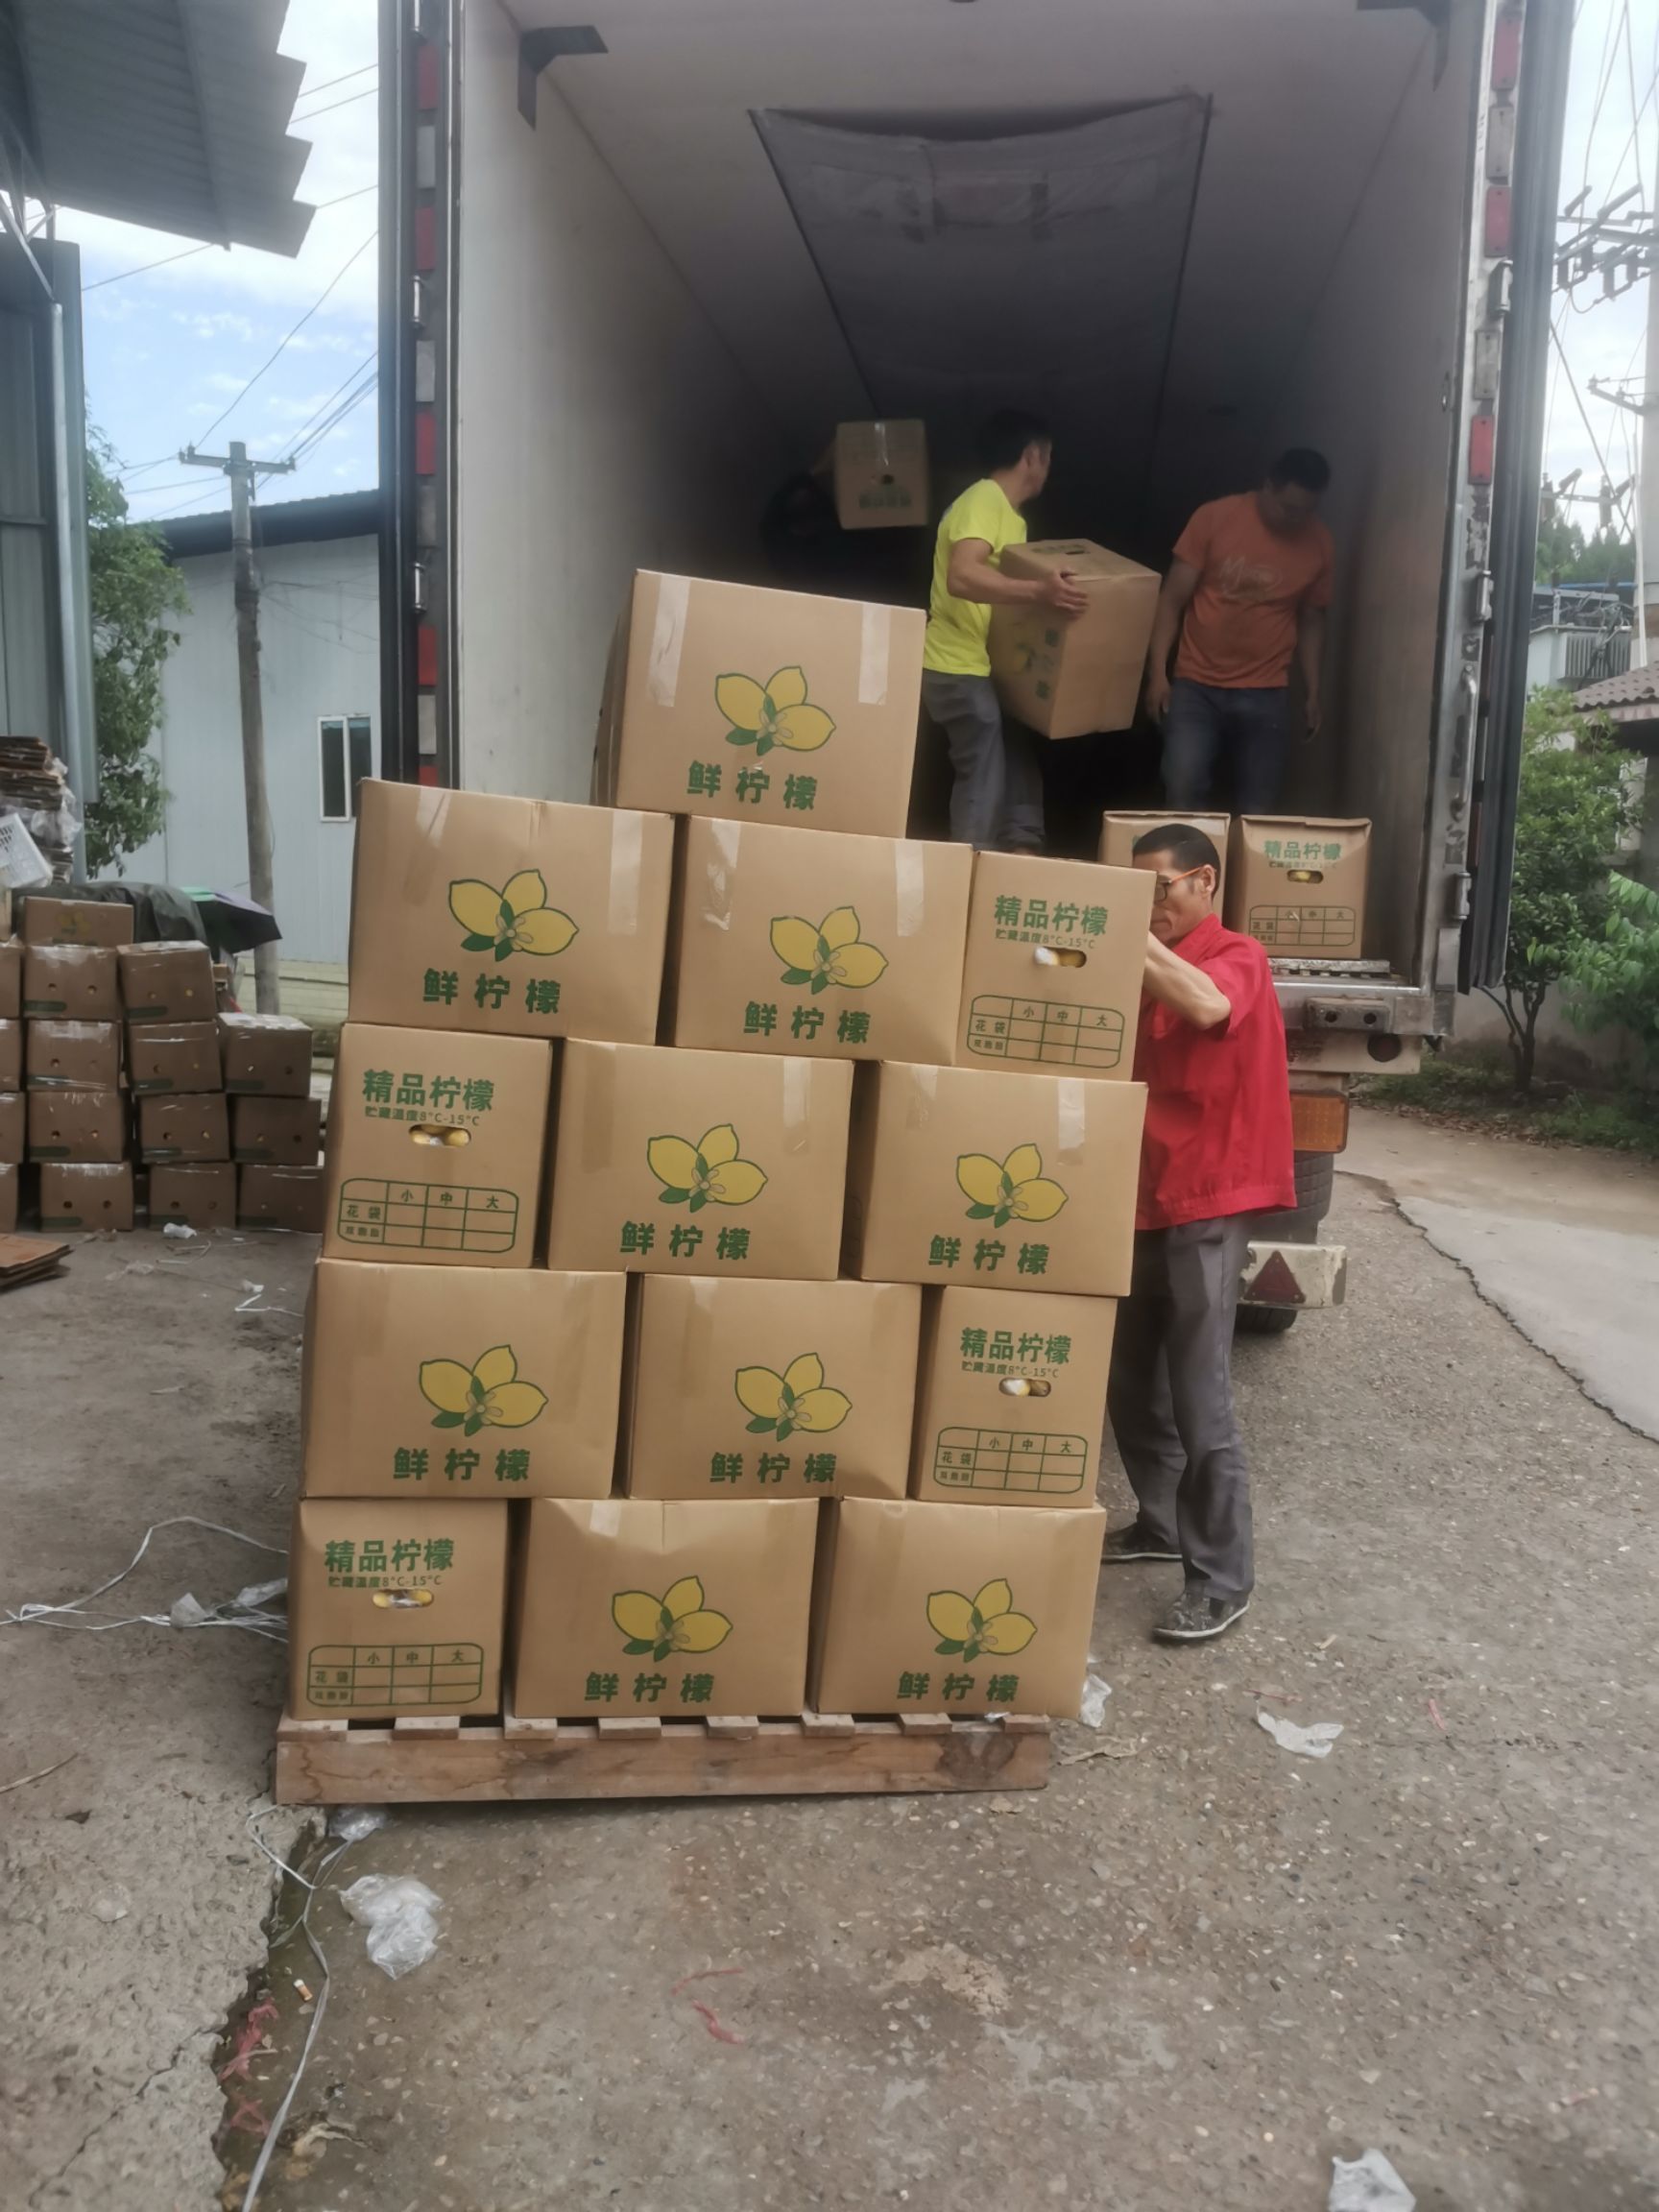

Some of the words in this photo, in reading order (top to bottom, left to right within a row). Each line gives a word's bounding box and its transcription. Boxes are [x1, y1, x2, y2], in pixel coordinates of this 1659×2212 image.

[686, 758, 817, 811] 鲜柠檬
[994, 895, 1108, 937] 精品柠檬
[422, 968, 561, 1015] 鲜柠檬
[744, 1001, 870, 1045] 鲜柠檬
[362, 1069, 494, 1112] 精品柠檬
[620, 1220, 751, 1261] 鲜柠檬
[928, 1235, 1050, 1275] 鲜柠檬
[960, 1327, 1071, 1365] 精品柠檬
[394, 1448, 530, 1481] 鲜柠檬
[711, 1453, 836, 1482] 鲜柠檬
[325, 1538, 454, 1573] 精品柠檬
[586, 1672, 713, 1702] 鲜柠檬
[898, 1671, 1019, 1703] 鲜柠檬
